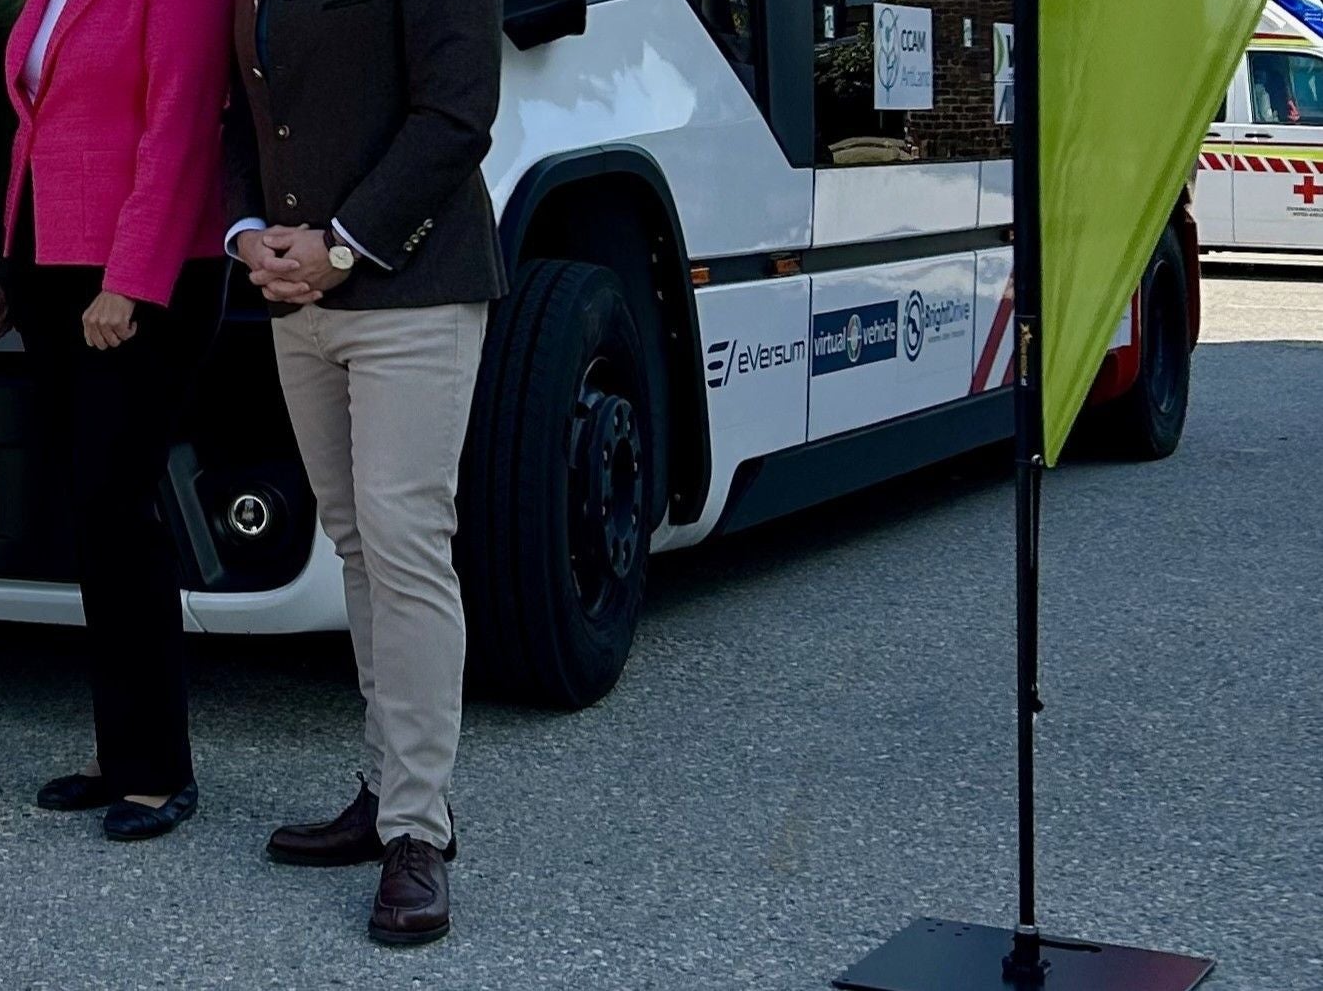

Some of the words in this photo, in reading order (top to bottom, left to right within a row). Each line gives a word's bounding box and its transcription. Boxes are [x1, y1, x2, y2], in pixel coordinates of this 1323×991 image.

[814, 326, 846, 357] virtual
[862, 317, 896, 346] vehicle
[738, 339, 806, 375] eVersum
